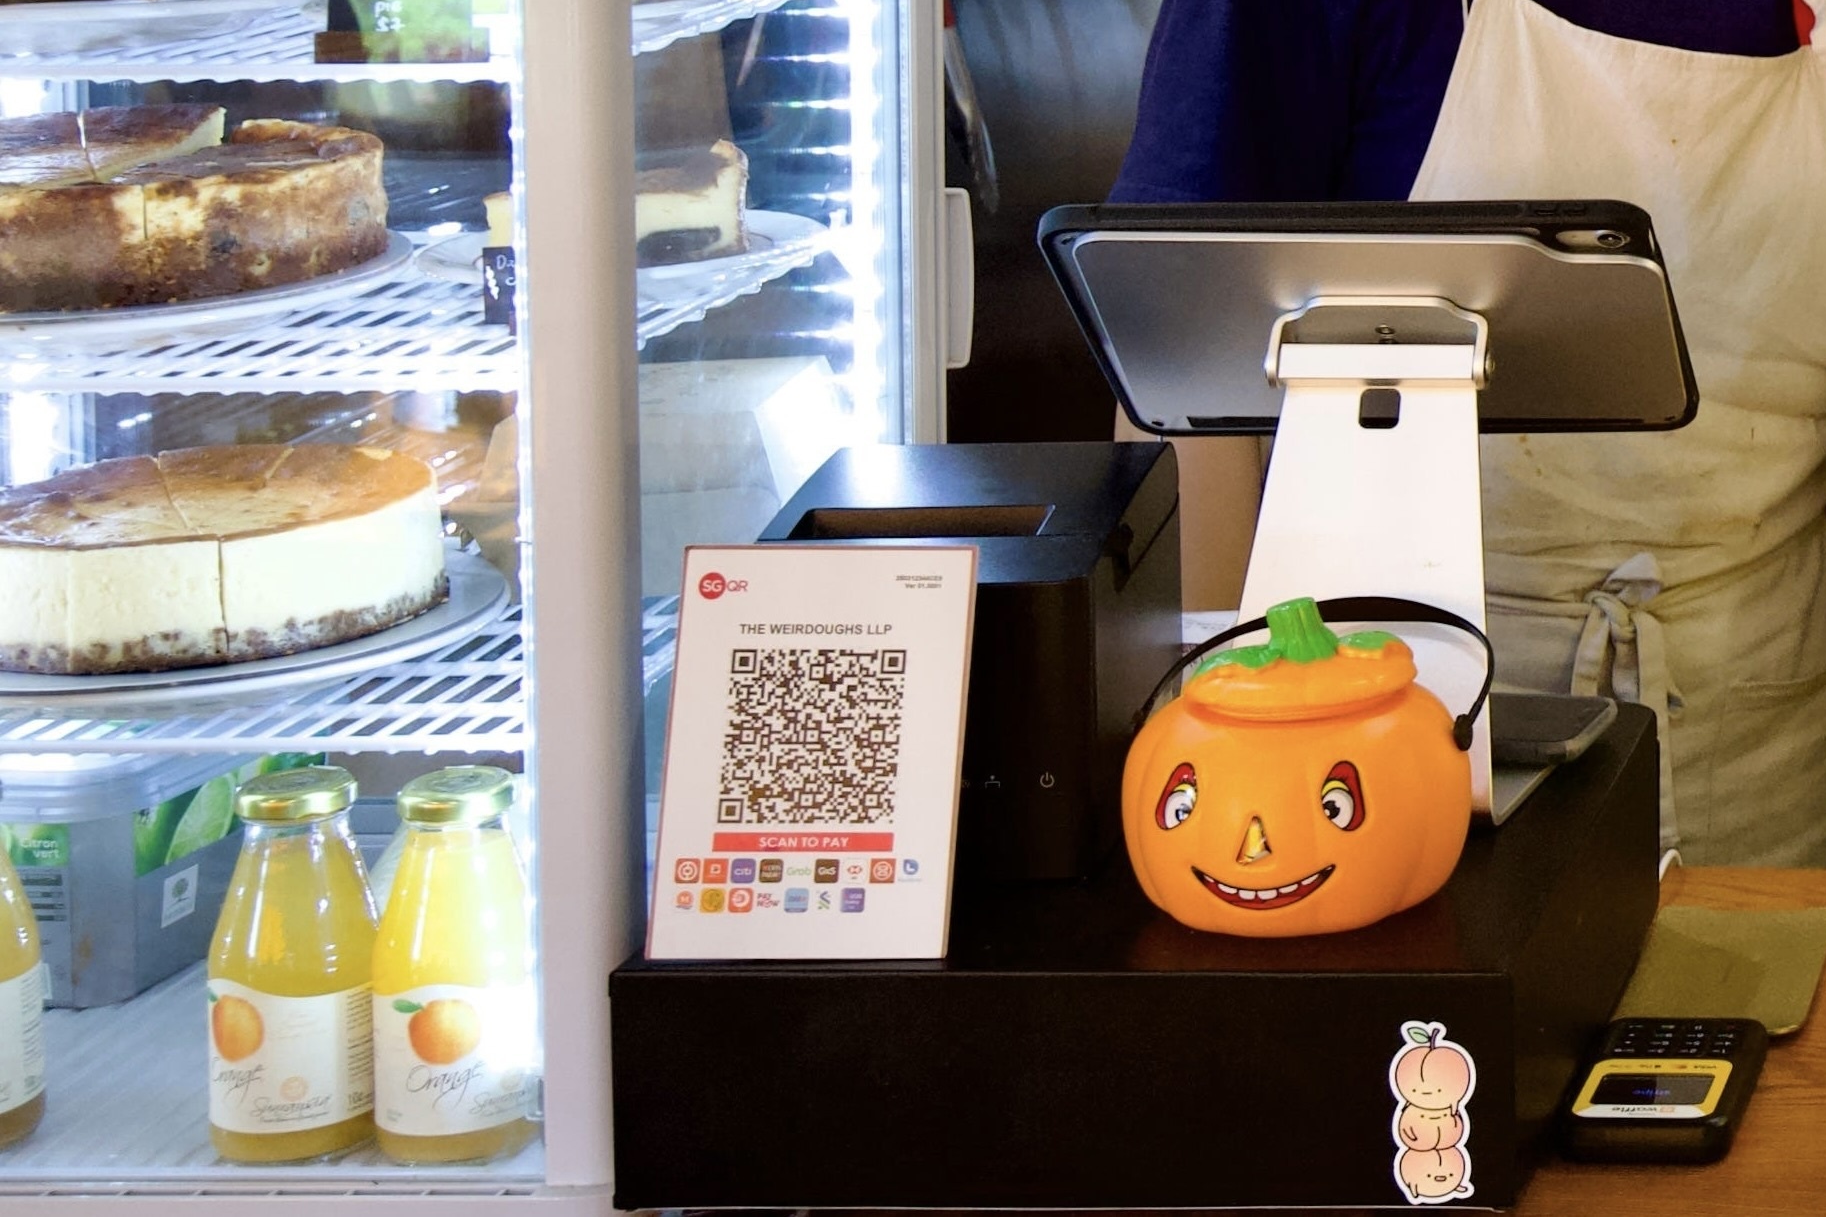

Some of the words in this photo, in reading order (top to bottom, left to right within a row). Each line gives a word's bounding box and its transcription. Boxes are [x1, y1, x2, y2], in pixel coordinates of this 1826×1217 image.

[740, 623, 766, 635] THE
[770, 623, 863, 635] WEIRDOUGHS
[867, 623, 892, 635] LLP
[20, 837, 58, 848] Citron
[758, 836, 797, 848] SCAN
[801, 836, 818, 847] TO
[823, 836, 849, 848] PAY
[33, 848, 60, 859] vert
[786, 866, 812, 877] Grab
[406, 1061, 486, 1110] Orange
